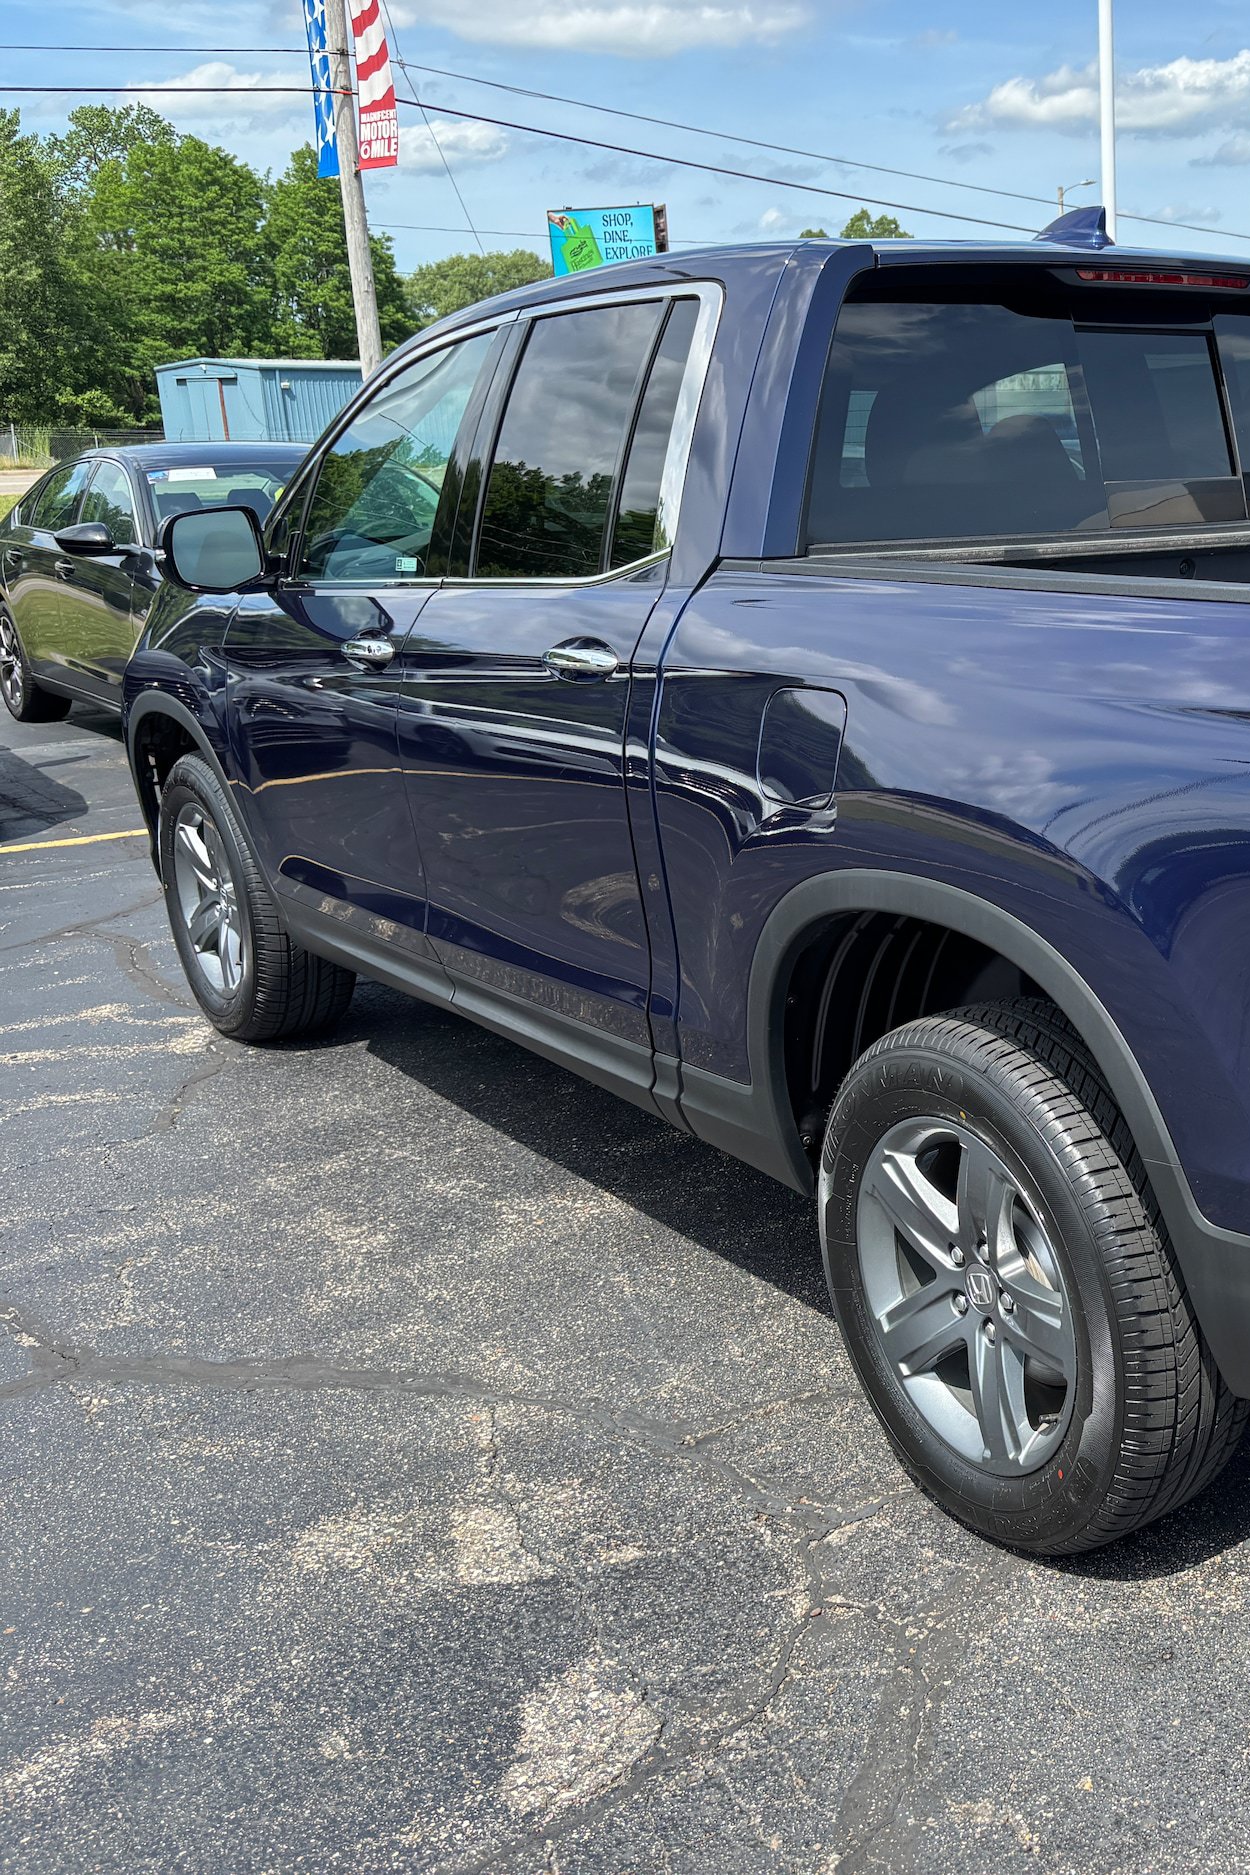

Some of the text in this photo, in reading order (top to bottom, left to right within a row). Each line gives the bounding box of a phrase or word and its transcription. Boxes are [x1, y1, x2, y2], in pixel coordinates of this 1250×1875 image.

[360, 120, 398, 142] MOTOR
[602, 213, 633, 227] SHOP,
[603, 230, 633, 244] DINE,
